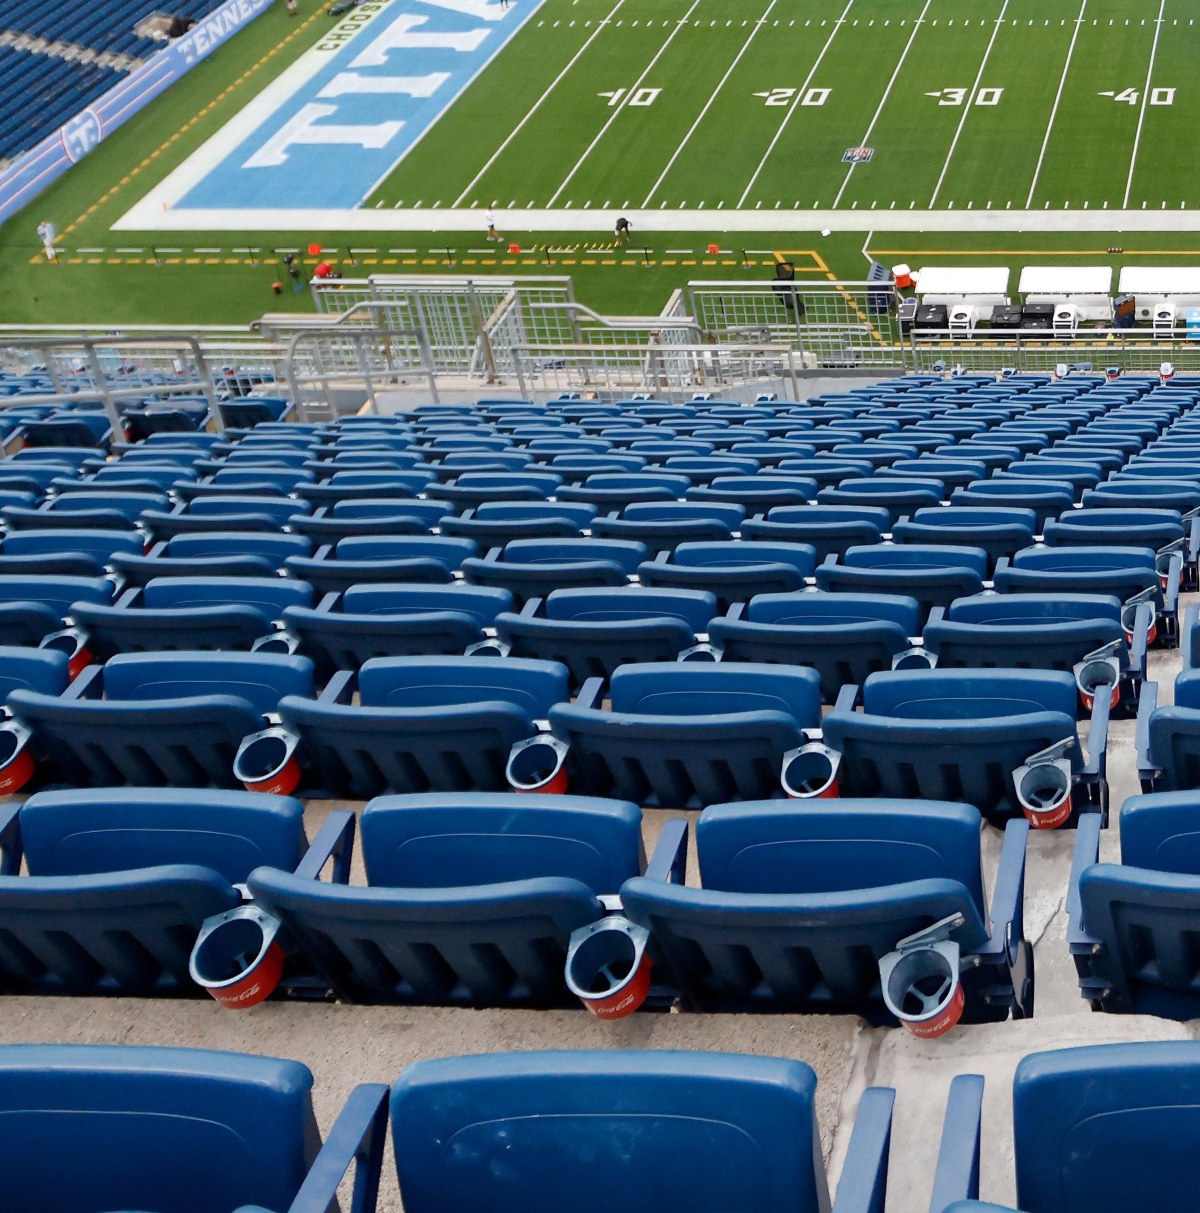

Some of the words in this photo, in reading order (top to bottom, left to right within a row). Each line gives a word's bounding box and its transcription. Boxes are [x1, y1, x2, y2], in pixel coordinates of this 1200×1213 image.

[607, 88, 663, 107] 10
[764, 88, 833, 107] 20
[936, 88, 1005, 107] 30
[1113, 87, 1178, 106] 40
